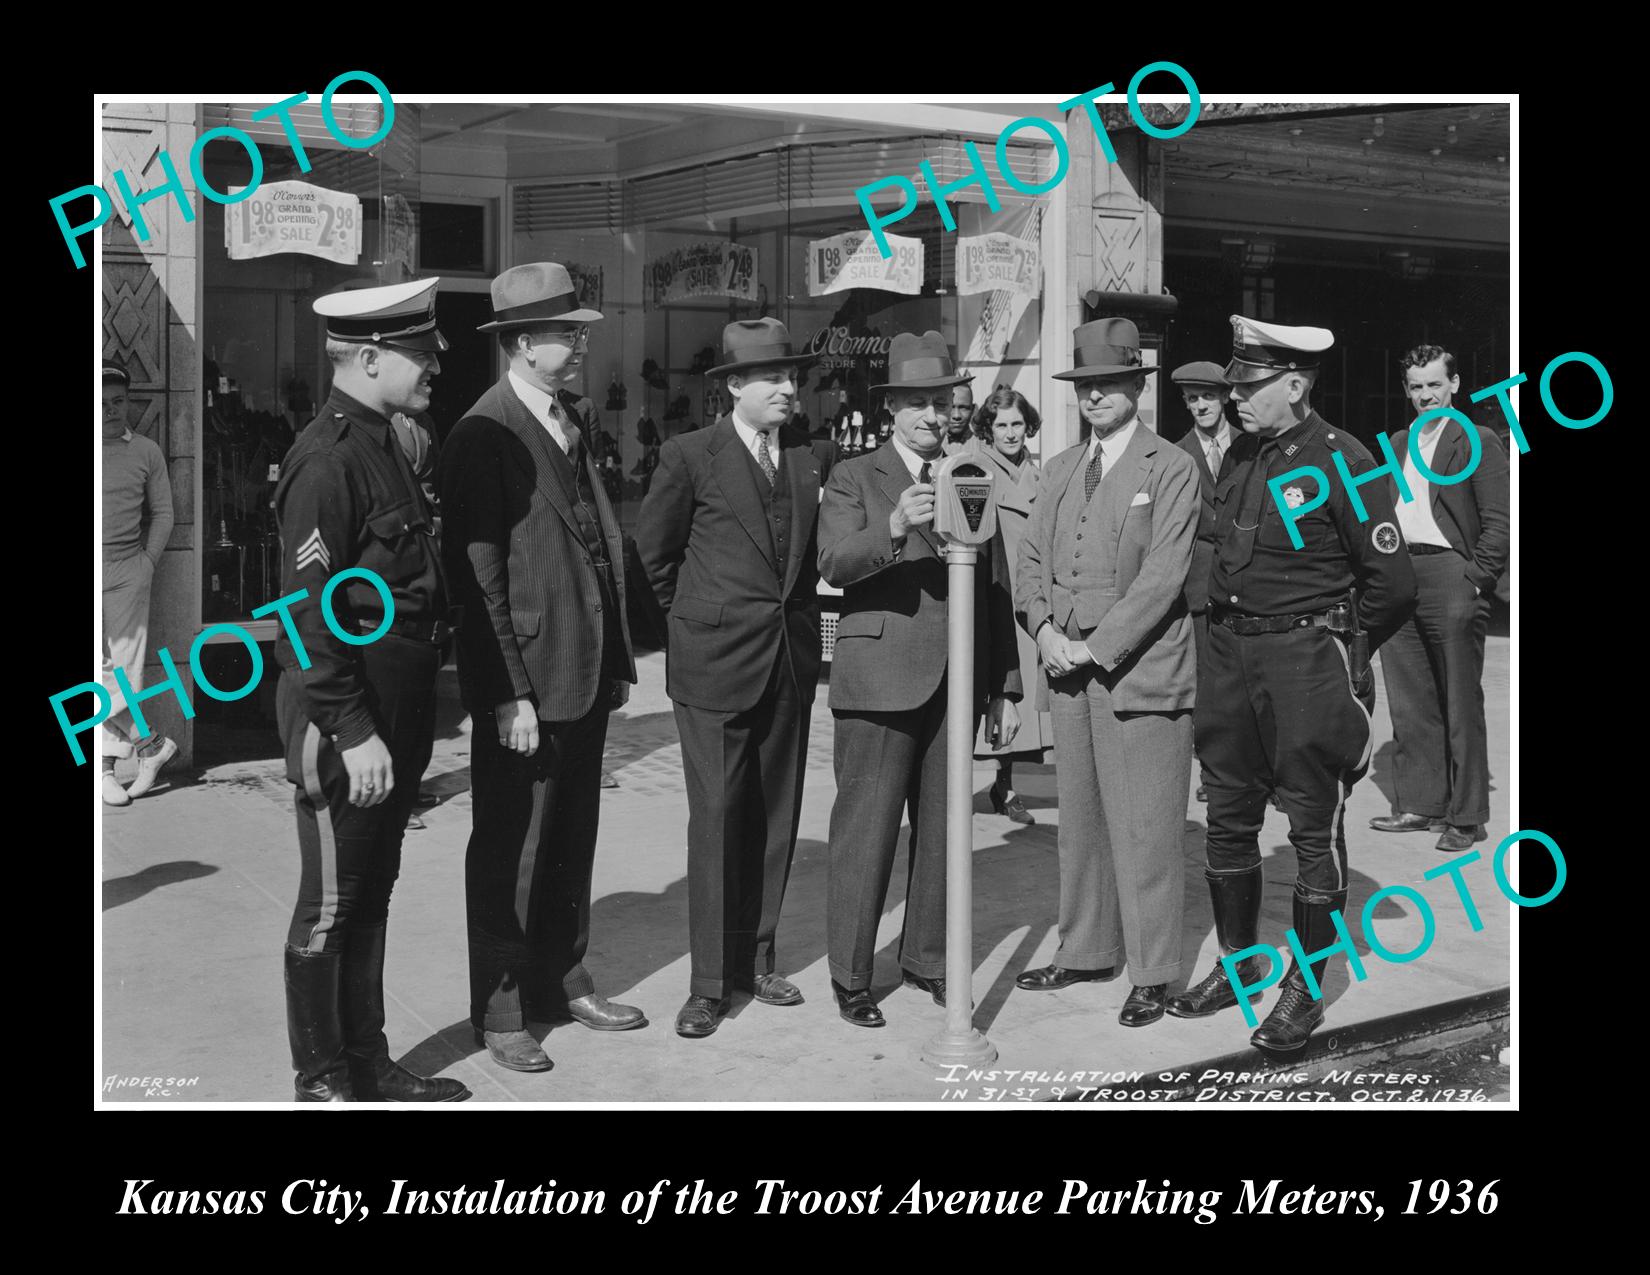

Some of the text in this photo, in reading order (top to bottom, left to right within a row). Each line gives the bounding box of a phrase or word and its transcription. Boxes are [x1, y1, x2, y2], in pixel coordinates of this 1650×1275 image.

[278, 204, 312, 213] GRAND
[277, 215, 317, 225] OPENING
[280, 227, 313, 241] SALE
[850, 266, 881, 280] SALE
[988, 265, 1013, 282] SALE
[822, 359, 857, 369] STORE
[960, 487, 969, 497] 60
